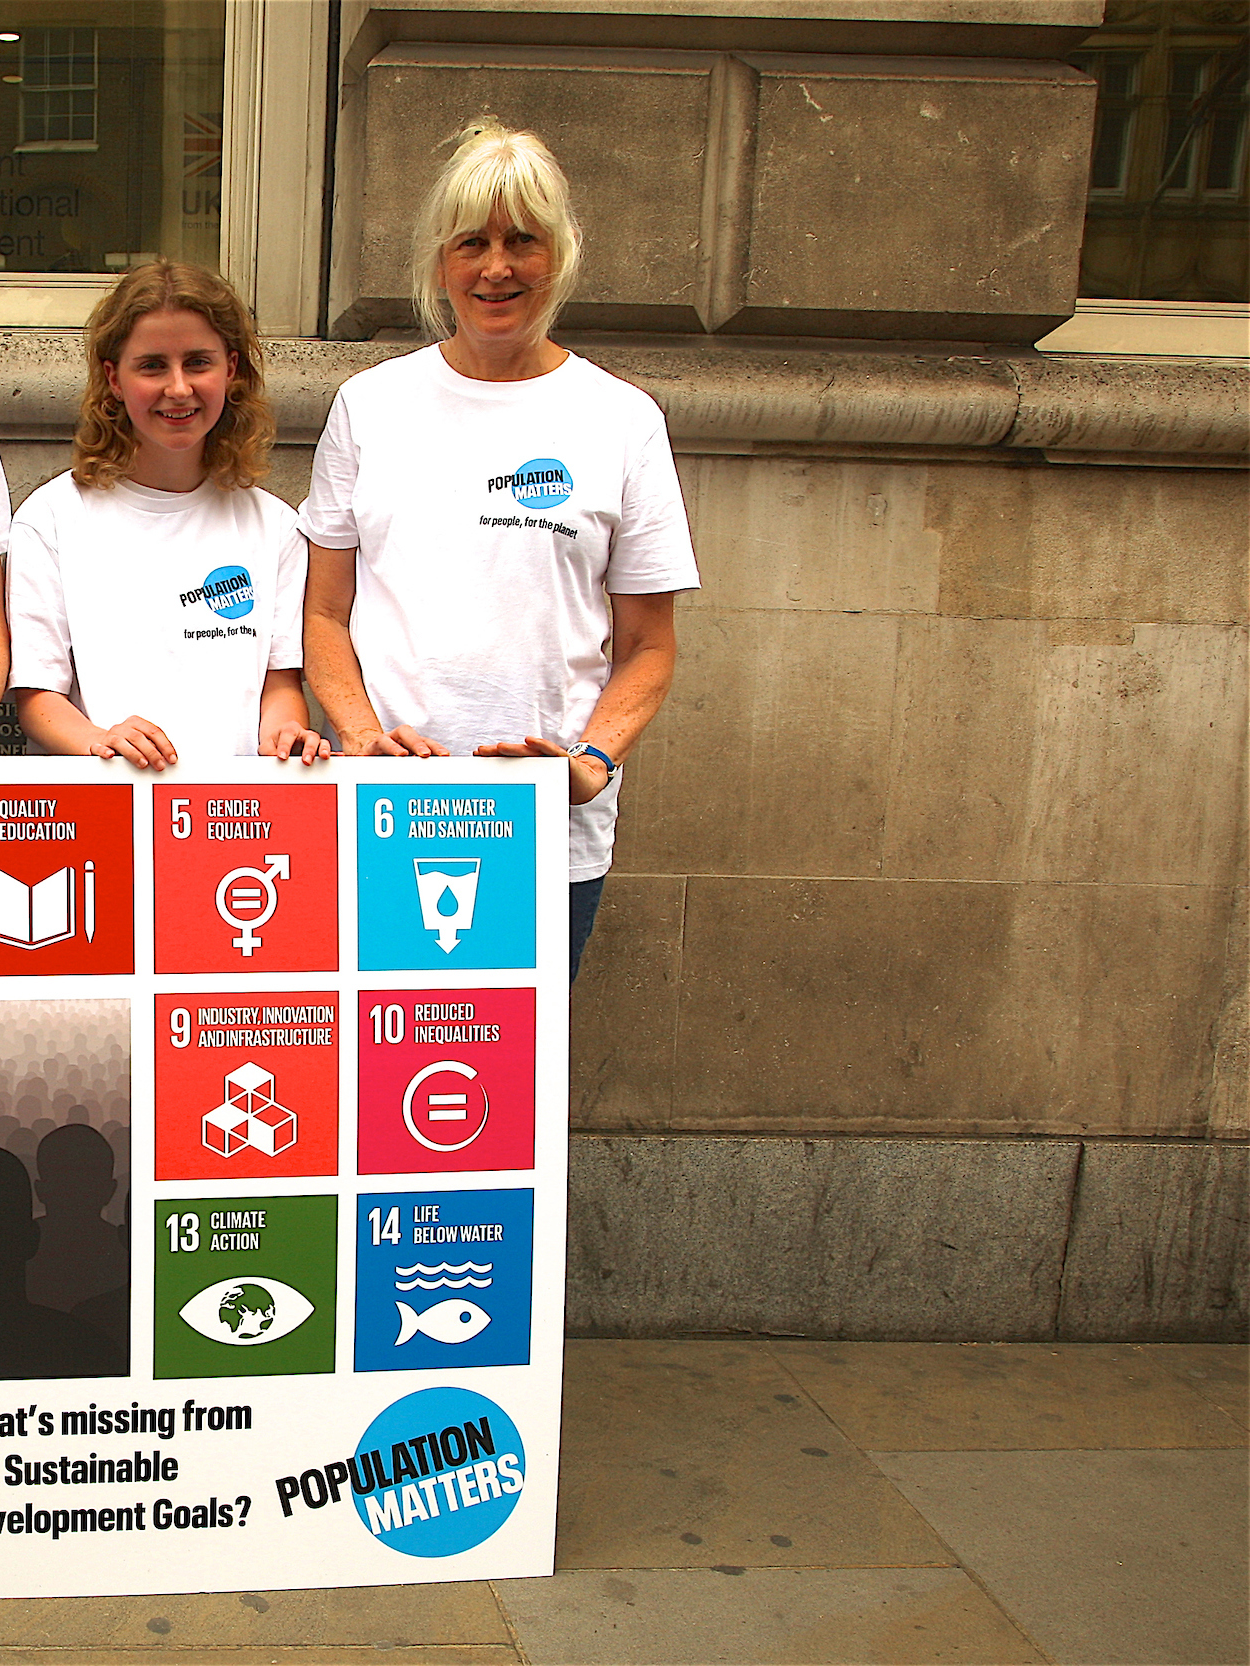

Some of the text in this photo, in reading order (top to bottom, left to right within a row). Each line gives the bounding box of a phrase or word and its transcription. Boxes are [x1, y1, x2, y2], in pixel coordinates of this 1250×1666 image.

[488, 469, 564, 493] POPULATION
[513, 482, 572, 500] MATTERS
[479, 515, 578, 539] for people, for the planet
[179, 572, 249, 607] POPULATION
[184, 629, 195, 639] for
[196, 627, 226, 641] people,
[227, 626, 239, 637] for
[240, 625, 252, 635] the
[0, 822, 75, 841] EDUCATION
[171, 798, 260, 839] 5 GENDER
[207, 821, 271, 841] EQUALITY
[374, 797, 496, 839] 6 CLEAN WATER
[408, 820, 513, 839] AND SANITATION
[170, 1005, 334, 1049] 9 INDUSTRY, INNOVATION
[198, 1027, 333, 1048] AND INFRASTRUCTURE
[369, 1003, 474, 1044] 10 REDUCED
[414, 1024, 500, 1045] INEQUALITIES
[166, 1210, 266, 1252] 13 CLIMATE
[210, 1232, 259, 1251] ACTION
[368, 1205, 440, 1246] 14 LIFE
[413, 1224, 503, 1244] BELOW WATER
[61, 1401, 175, 1440] missing
[182, 1399, 252, 1432] from
[4, 1450, 179, 1486] Sustainable
[275, 1416, 496, 1517] POPULATION
[364, 1453, 524, 1536] MATTERS
[153, 1495, 252, 1530] Goals?
